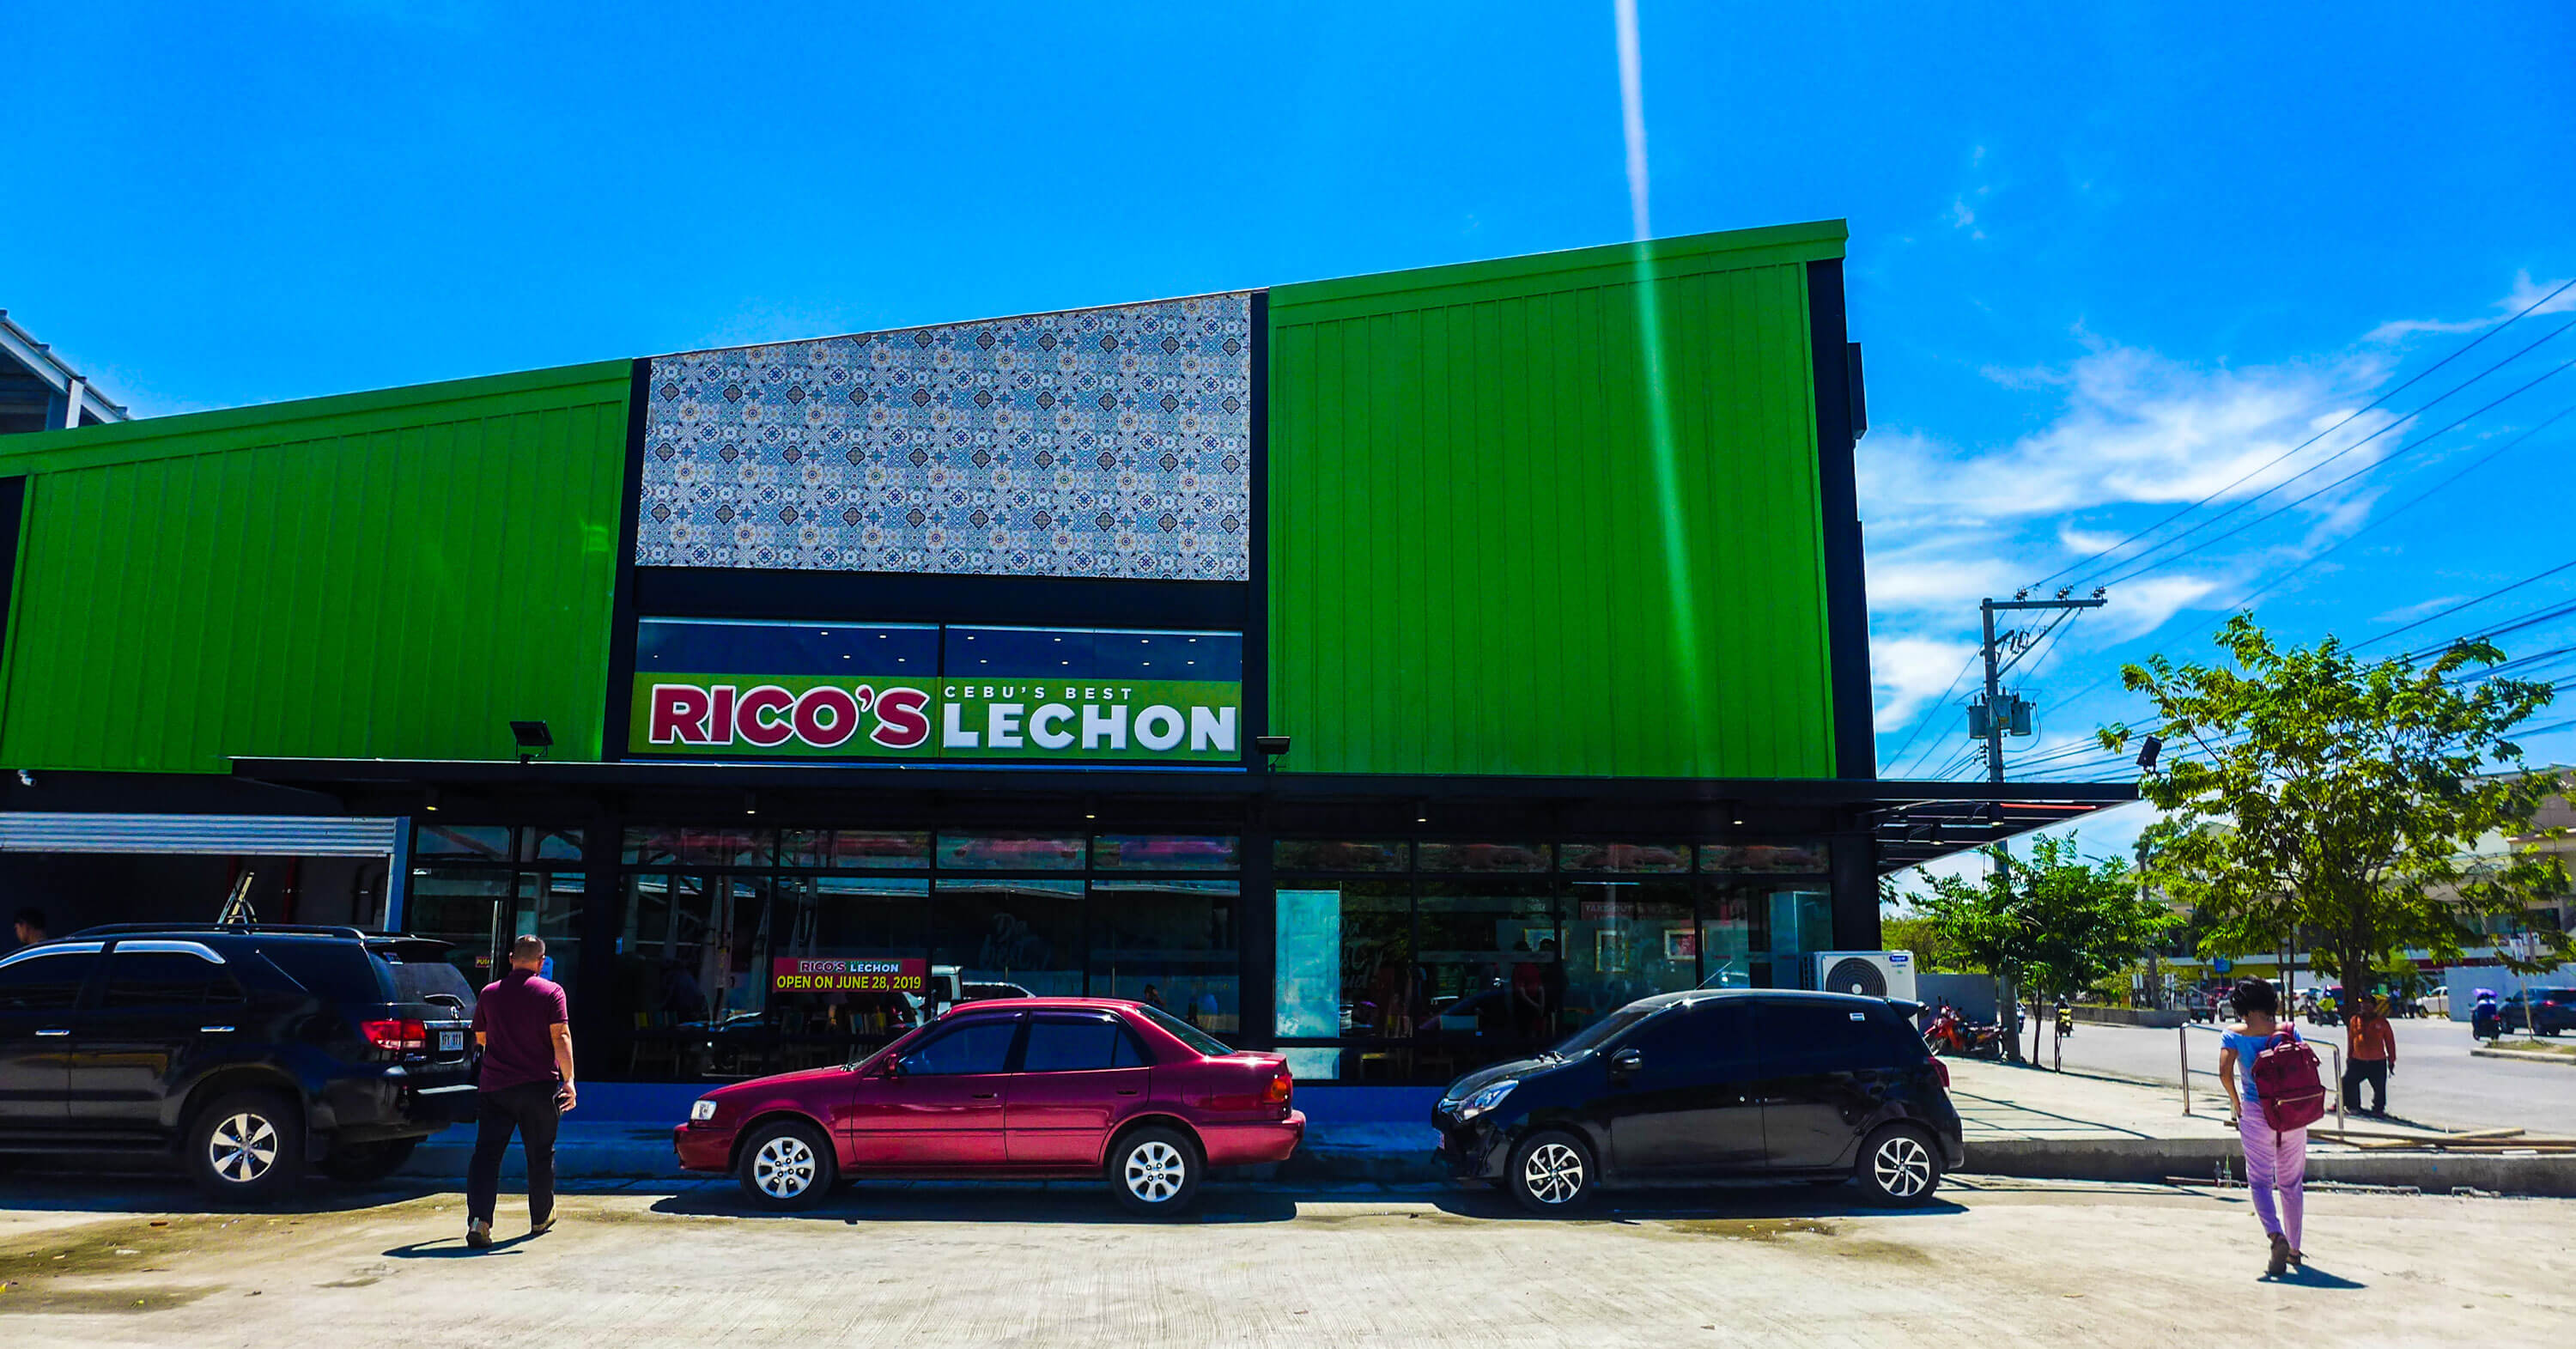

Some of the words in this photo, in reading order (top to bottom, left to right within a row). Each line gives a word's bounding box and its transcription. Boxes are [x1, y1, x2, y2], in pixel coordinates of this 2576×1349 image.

[945, 685, 1047, 700] CEBU'S
[1065, 687, 1133, 701] BEST
[648, 684, 931, 749] RICO'S
[944, 703, 1236, 751] LECHON
[800, 961, 846, 973] RICO'S
[850, 963, 899, 972] LECHON
[776, 975, 811, 989] OPEN
[814, 975, 833, 989] ON
[836, 975, 869, 989] JUNE
[872, 976, 890, 993] 28,
[893, 976, 921, 989] 2019
